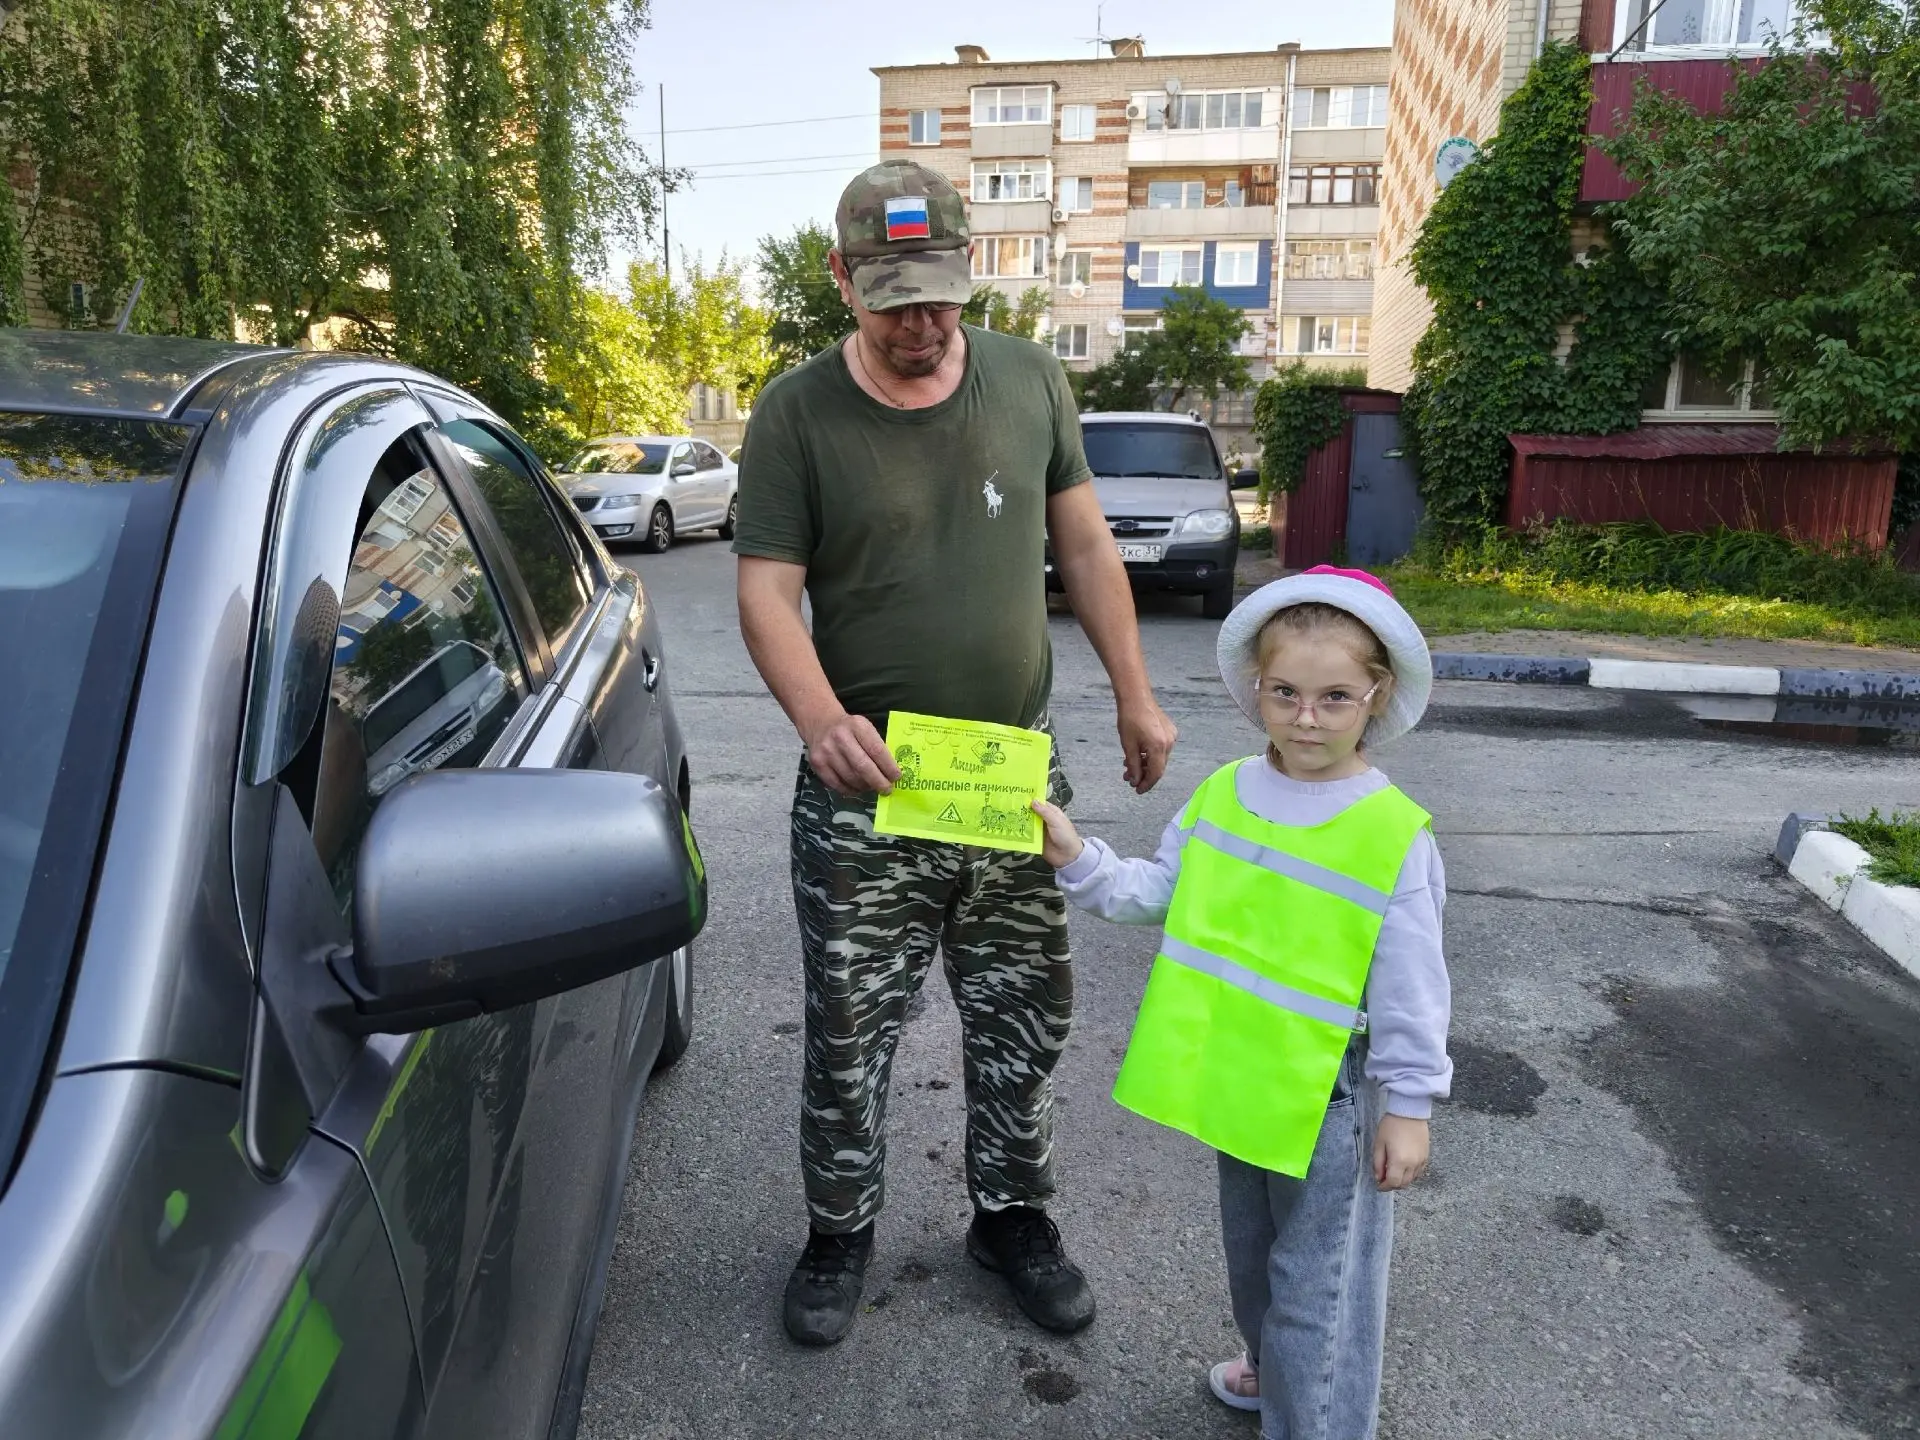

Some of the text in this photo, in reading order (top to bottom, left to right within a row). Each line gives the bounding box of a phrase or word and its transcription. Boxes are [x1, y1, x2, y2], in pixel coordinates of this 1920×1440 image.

[1119, 545, 1157, 558] 3КС 31
[950, 757, 986, 774] Акция
